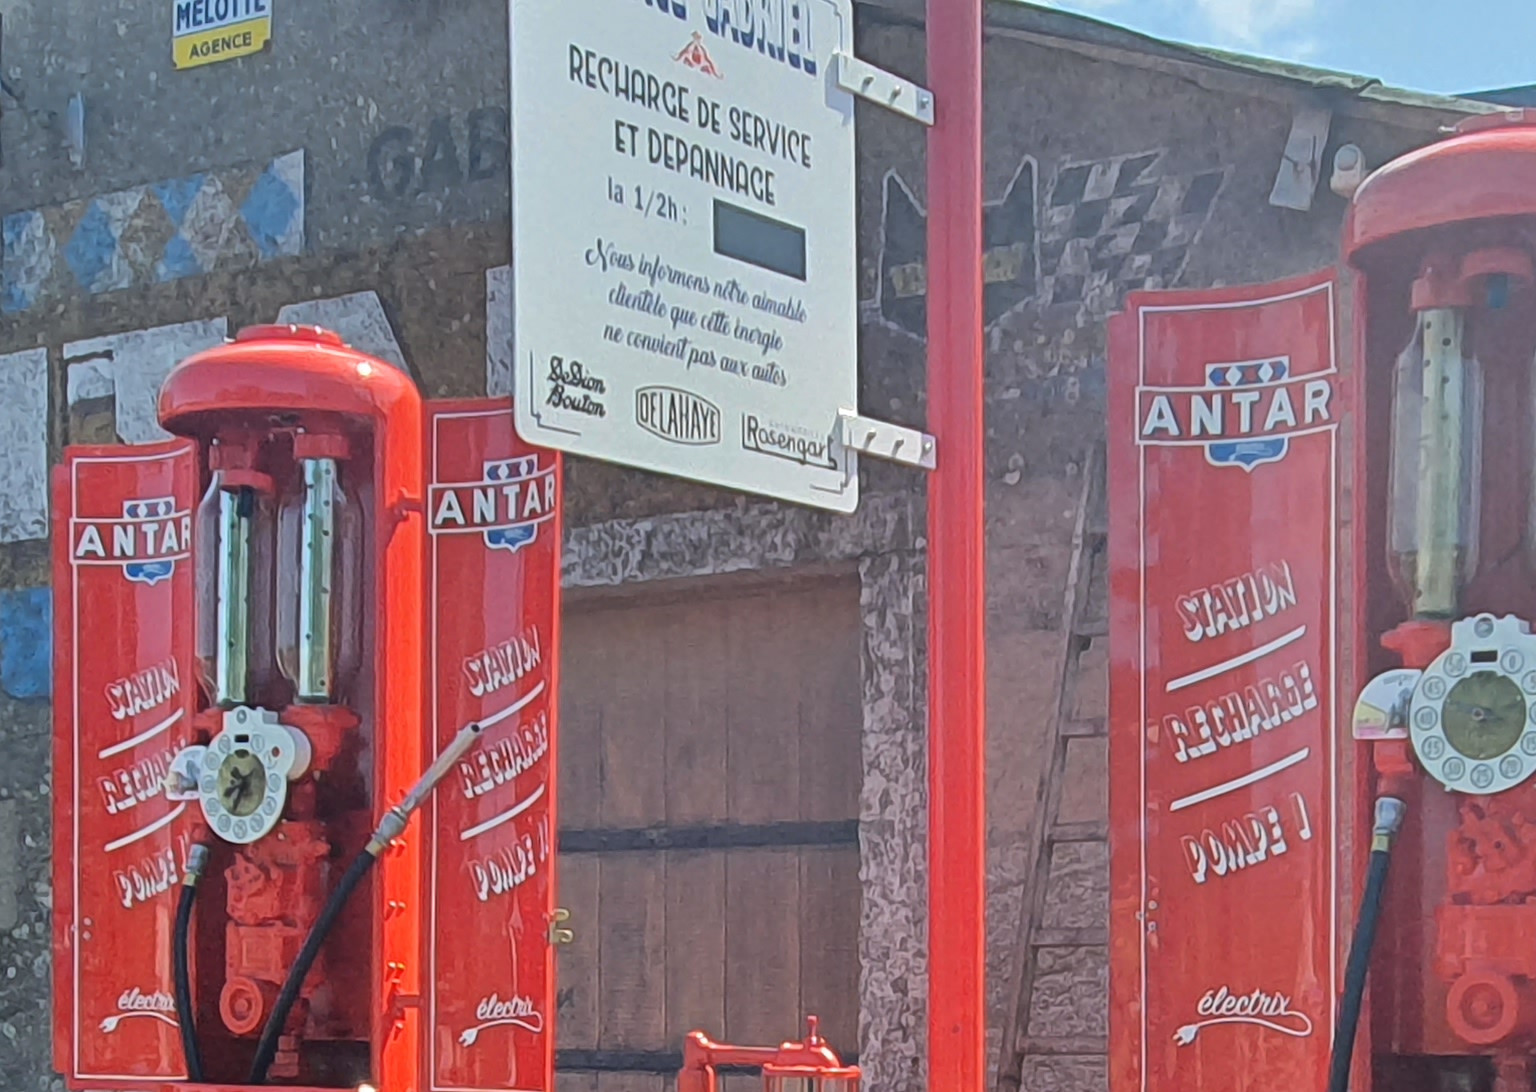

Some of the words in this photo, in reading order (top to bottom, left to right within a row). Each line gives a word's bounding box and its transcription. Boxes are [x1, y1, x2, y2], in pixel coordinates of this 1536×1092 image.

[189, 31, 252, 60] AGENCE
[568, 43, 689, 123] RECHARGE
[697, 96, 721, 134] DE
[729, 106, 812, 169] SERVICE
[608, 176, 624, 204] la
[614, 119, 639, 157] ET
[648, 127, 776, 206] DEPANNAGE
[585, 237, 635, 272] Nous
[638, 253, 710, 294] informons
[752, 290, 807, 324] aimable
[670, 304, 698, 331] que
[603, 324, 623, 344] ne
[626, 331, 688, 361] convient
[687, 346, 717, 370] pas
[720, 355, 749, 377] aux
[752, 361, 787, 387] autos
[546, 384, 606, 419] Bouton
[640, 392, 717, 440] DELAHAYE
[1142, 380, 1331, 436] ANTAR
[434, 474, 555, 525] ANTAR
[75, 517, 191, 558] ANTAR
[1175, 559, 1297, 642] STATION
[104, 655, 180, 720] STATION
[462, 624, 541, 697] STATION
[1163, 660, 1318, 763] RECHARGE
[96, 737, 187, 815] RECHA
[456, 709, 548, 799] RECHARGE
[467, 833, 536, 902] POMPE
[1180, 804, 1287, 884] POMPE
[112, 848, 178, 908] POMPE
[1197, 985, 1290, 1016] électrix
